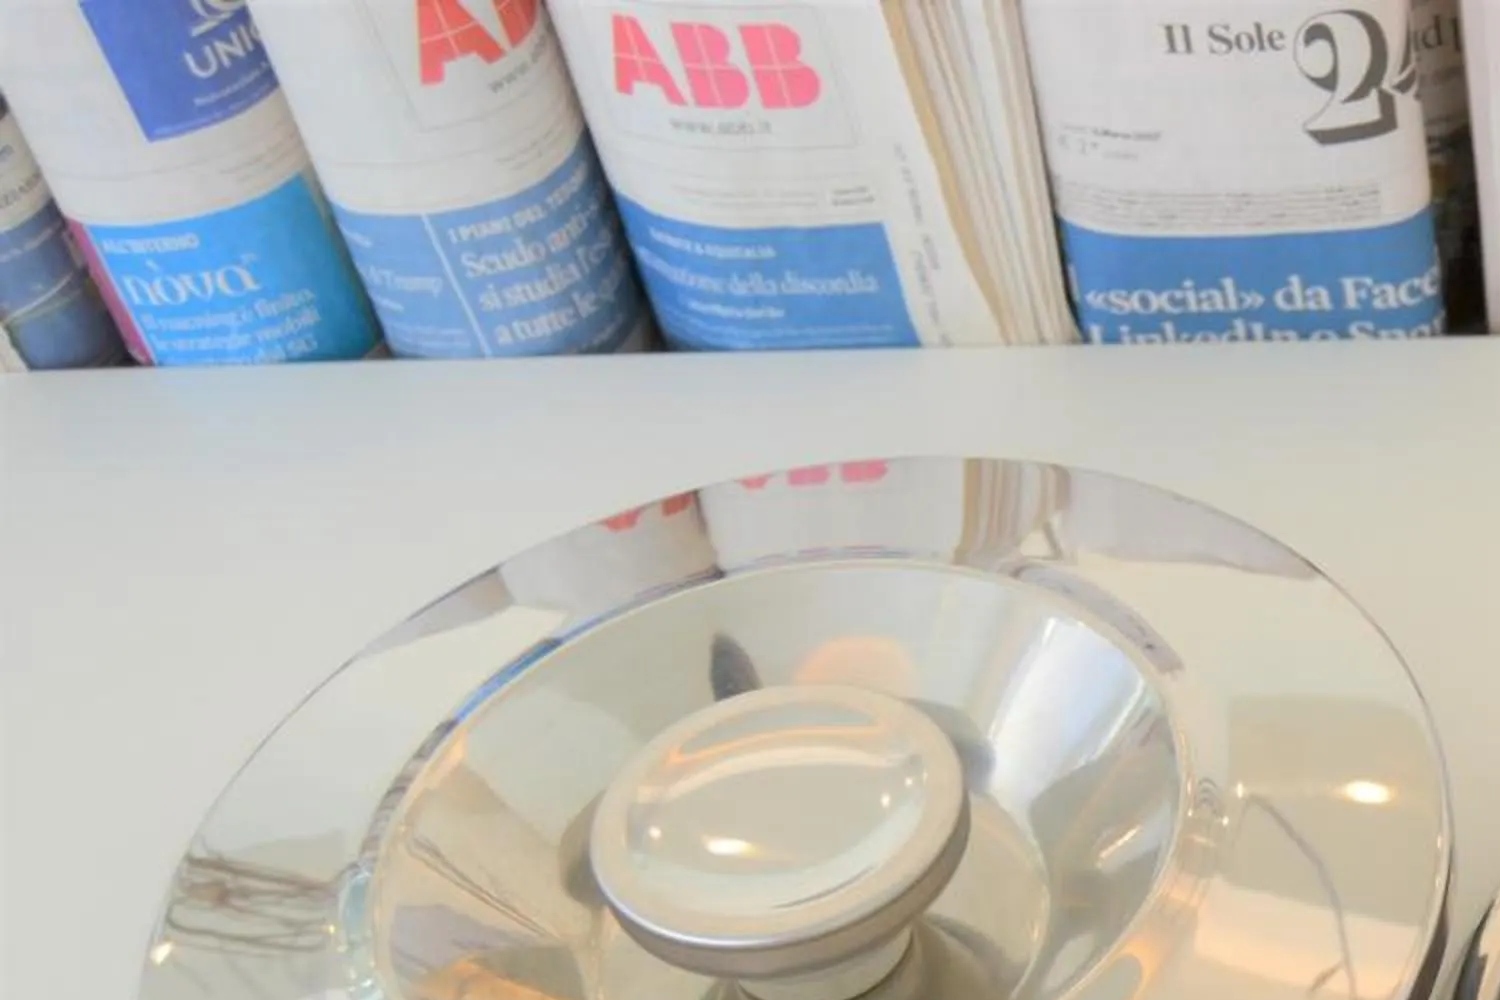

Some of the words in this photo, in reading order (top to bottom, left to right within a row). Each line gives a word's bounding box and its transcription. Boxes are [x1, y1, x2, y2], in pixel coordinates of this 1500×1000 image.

[1163, 23, 1194, 54] Il
[1208, 21, 1287, 55] Sole
[611, 13, 822, 110] ABB
[460, 237, 546, 279] Scudo
[479, 283, 504, 312] si
[505, 263, 583, 307] studia
[728, 271, 778, 296] della
[780, 269, 879, 296] discordia
[1084, 274, 1265, 315] «social»
[1274, 274, 1333, 312] da
[495, 324, 513, 347] a
[512, 308, 577, 343] tutte
